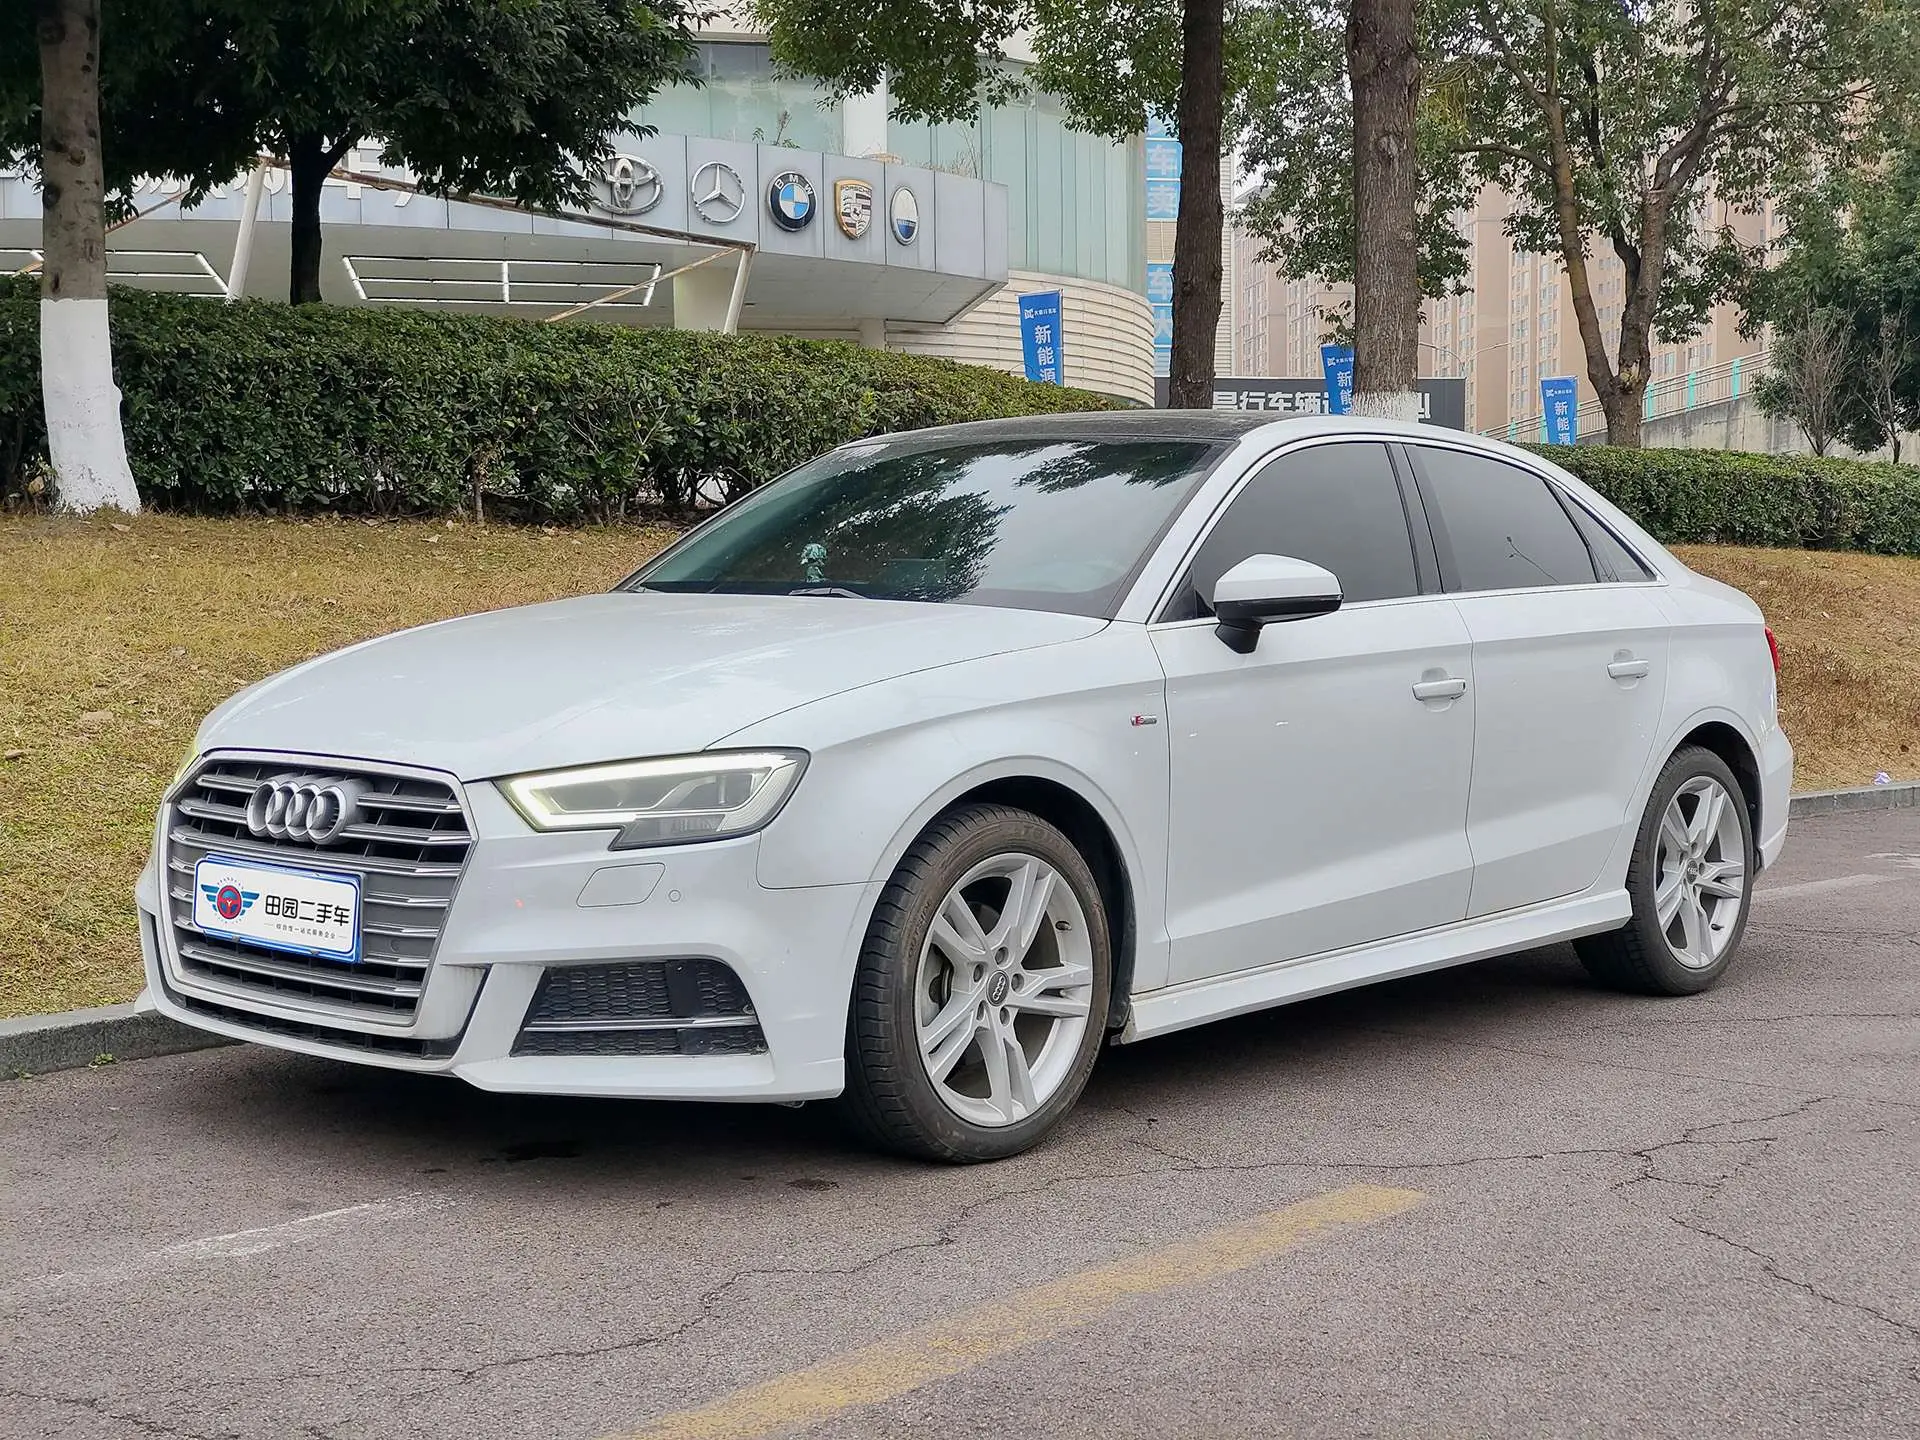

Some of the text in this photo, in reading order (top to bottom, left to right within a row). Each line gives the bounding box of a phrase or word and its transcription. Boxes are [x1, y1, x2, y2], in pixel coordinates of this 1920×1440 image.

[775, 174, 813, 195] BMW
[1034, 324, 1057, 384] 新能源
[265, 895, 350, 926] 田园二手车
